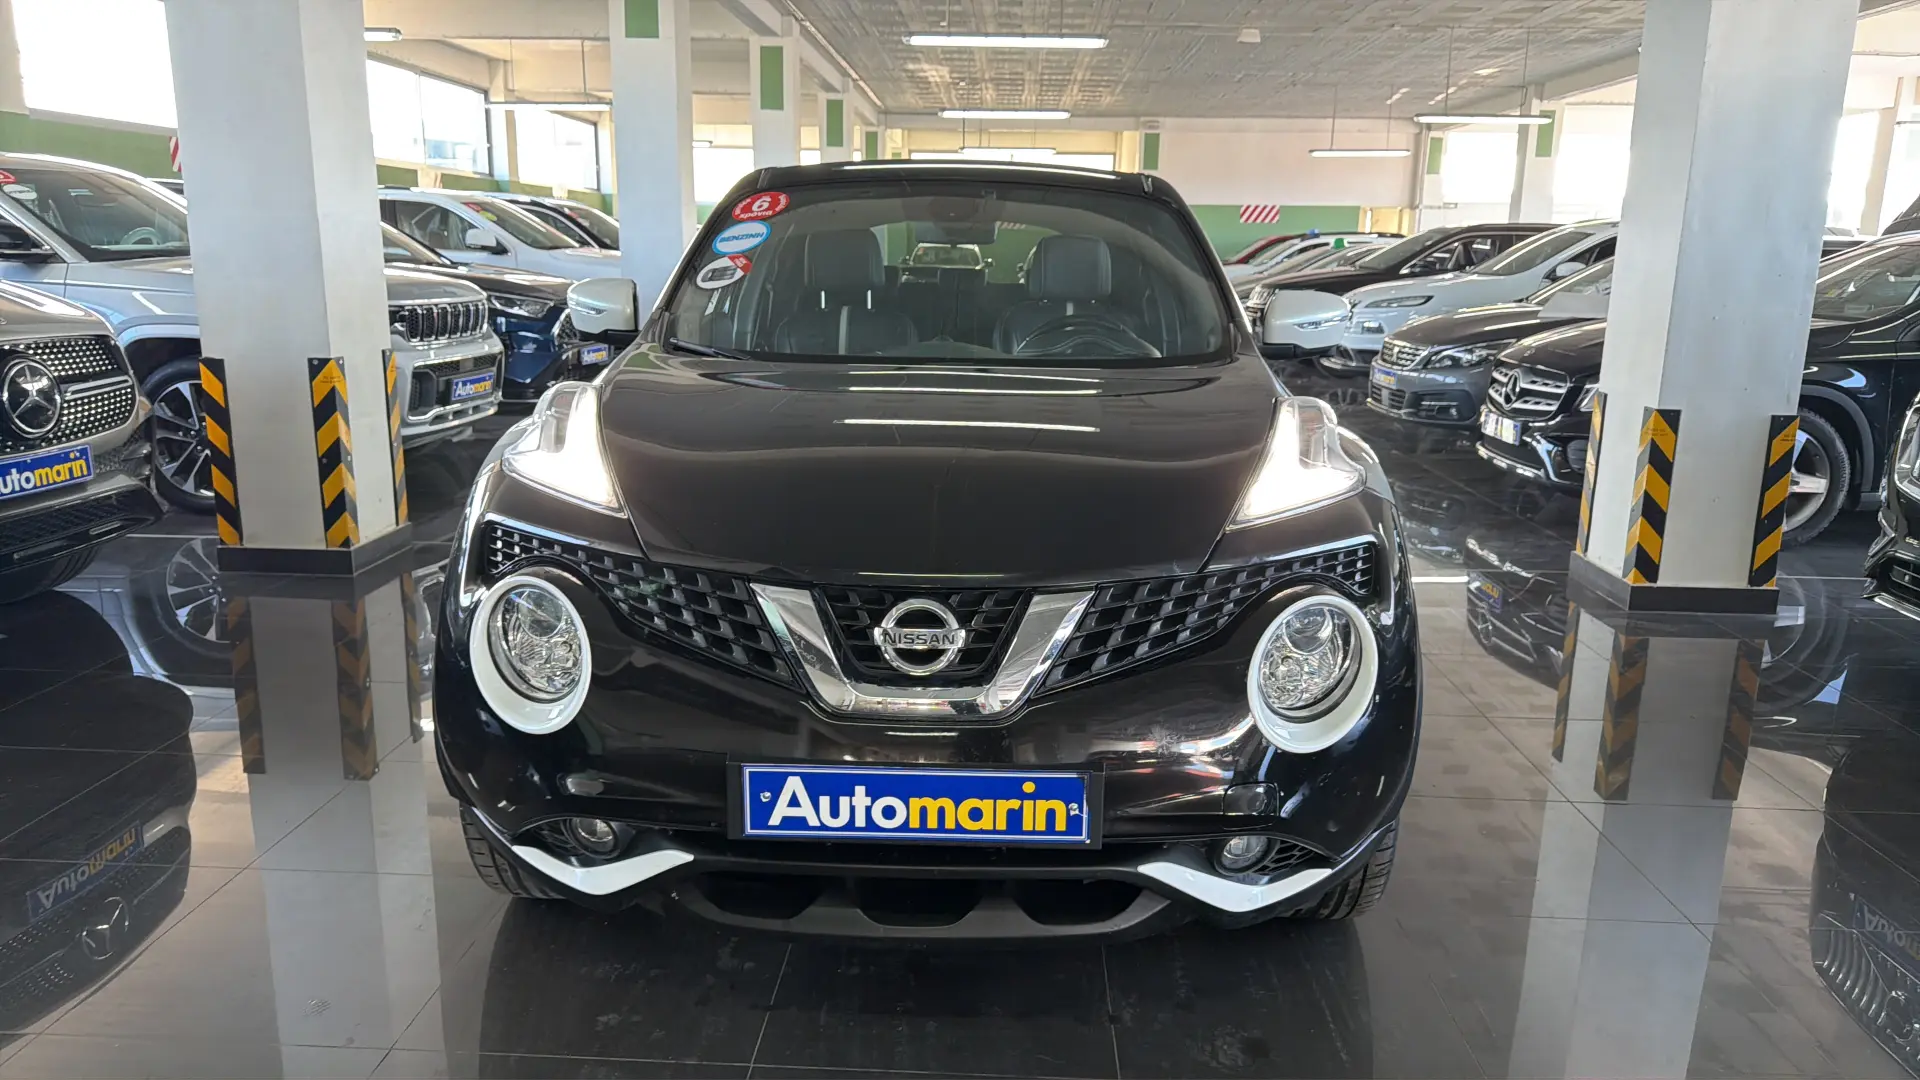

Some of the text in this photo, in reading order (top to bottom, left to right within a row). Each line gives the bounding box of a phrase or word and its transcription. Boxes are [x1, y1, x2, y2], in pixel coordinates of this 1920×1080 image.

[752, 197, 771, 211] 6
[0, 451, 88, 494] utomarin
[883, 632, 955, 644] NISSAN
[767, 776, 1067, 831] Automarin
